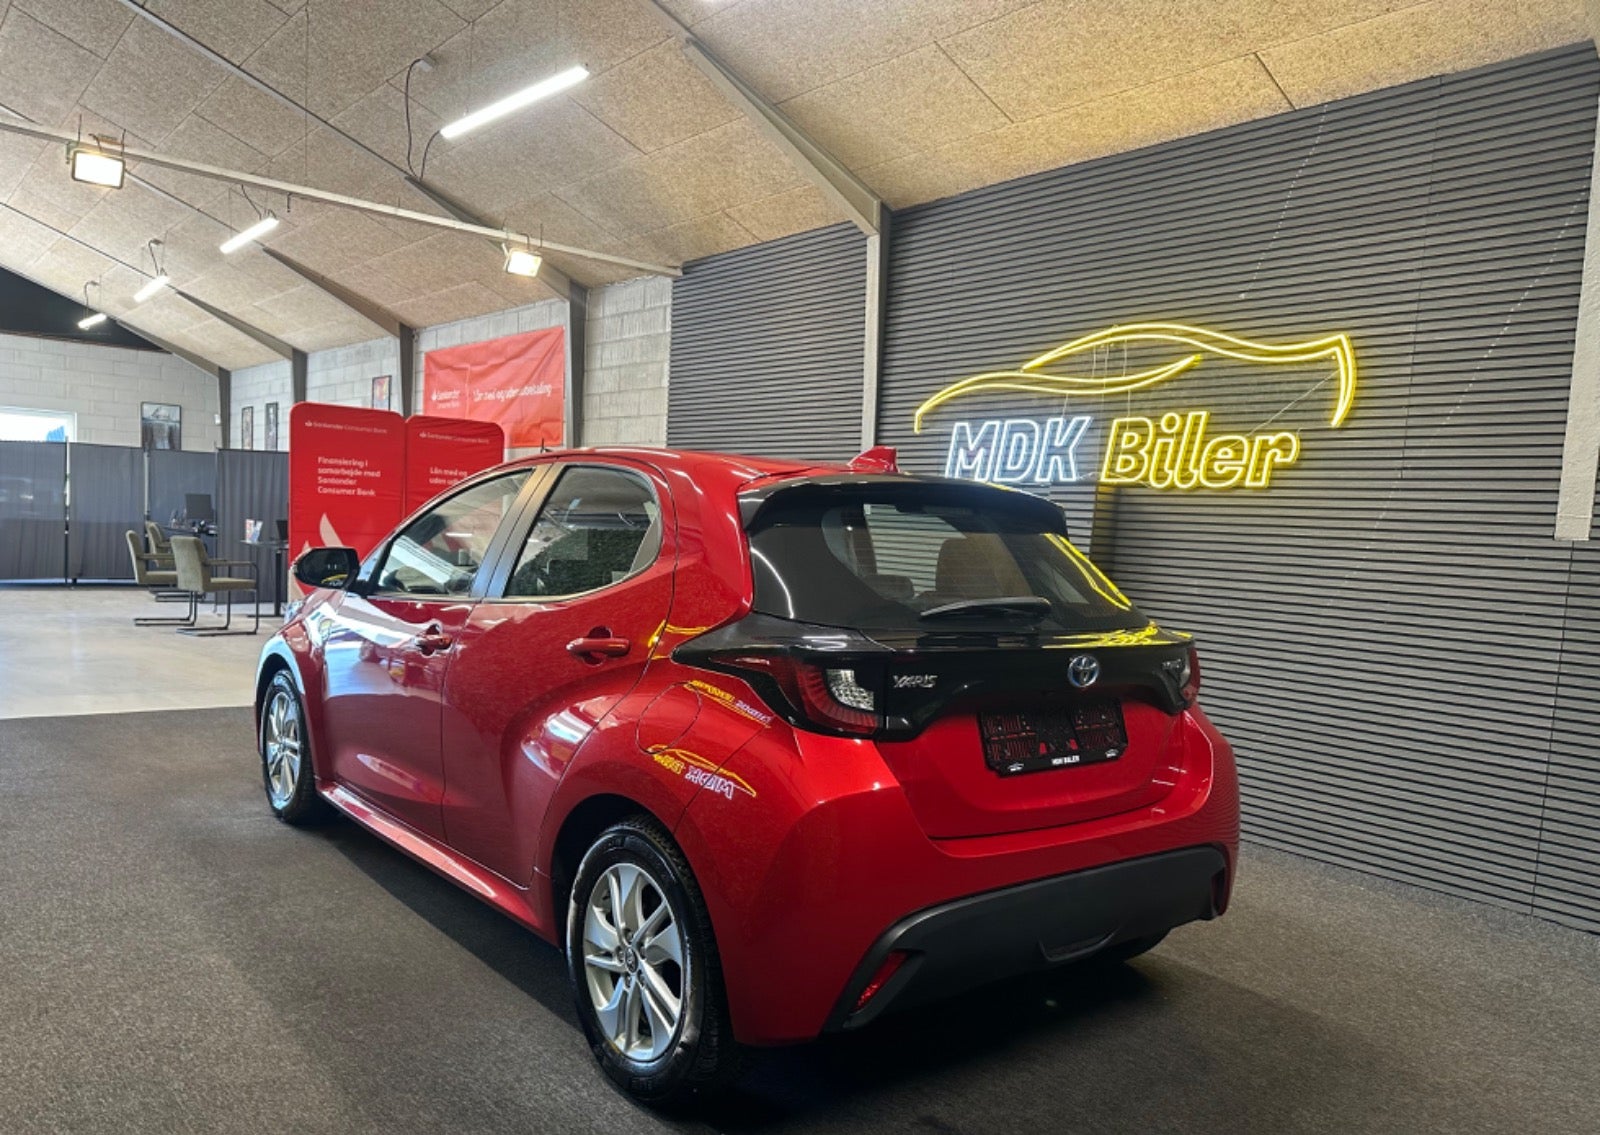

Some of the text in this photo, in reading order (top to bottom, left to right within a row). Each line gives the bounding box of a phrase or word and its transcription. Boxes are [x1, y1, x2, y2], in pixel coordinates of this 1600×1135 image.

[944, 411, 1299, 489] MDK Biler
[318, 456, 365, 469] Finansiering
[317, 467, 382, 478] samarbejde med
[317, 476, 358, 486] Santander
[317, 486, 377, 497] Consumer Bank
[892, 674, 938, 688] YARIS
